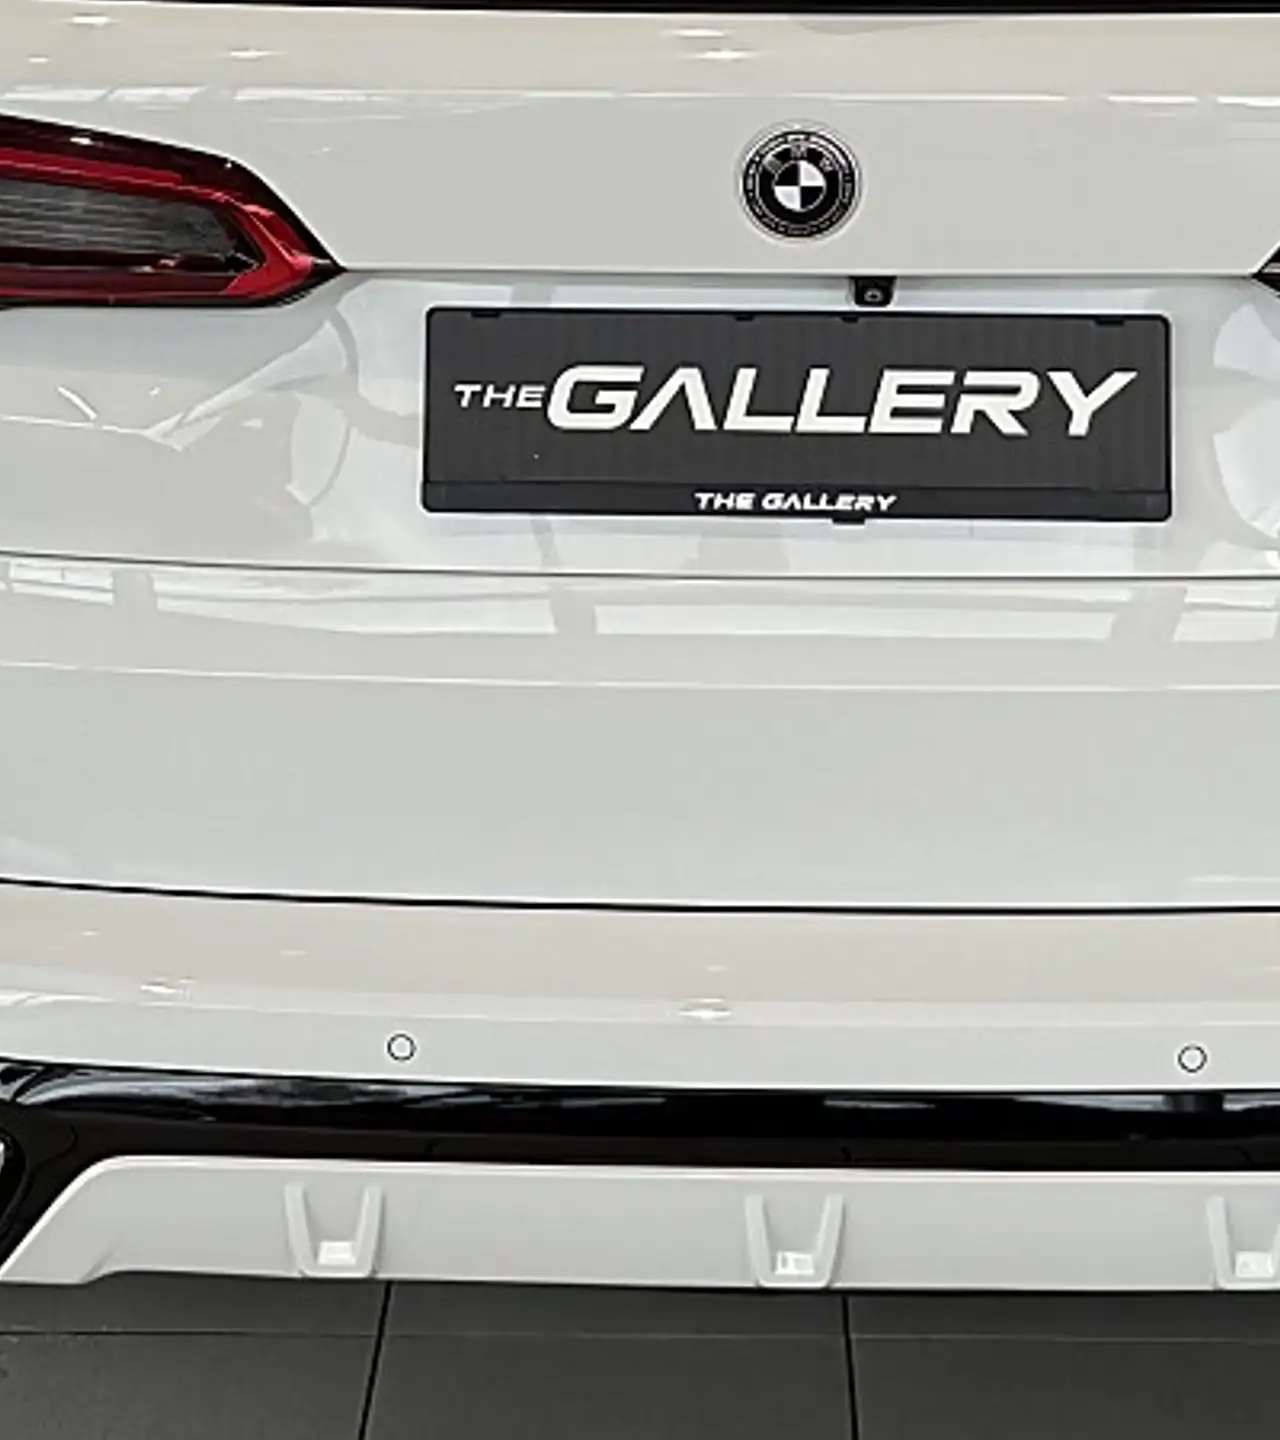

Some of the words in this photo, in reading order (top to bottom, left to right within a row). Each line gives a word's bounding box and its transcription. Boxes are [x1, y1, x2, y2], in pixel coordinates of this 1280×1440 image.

[454, 384, 546, 408] THE
[546, 365, 1138, 437] GALLERY
[694, 492, 756, 510] THE
[761, 492, 897, 511] GALLERY
